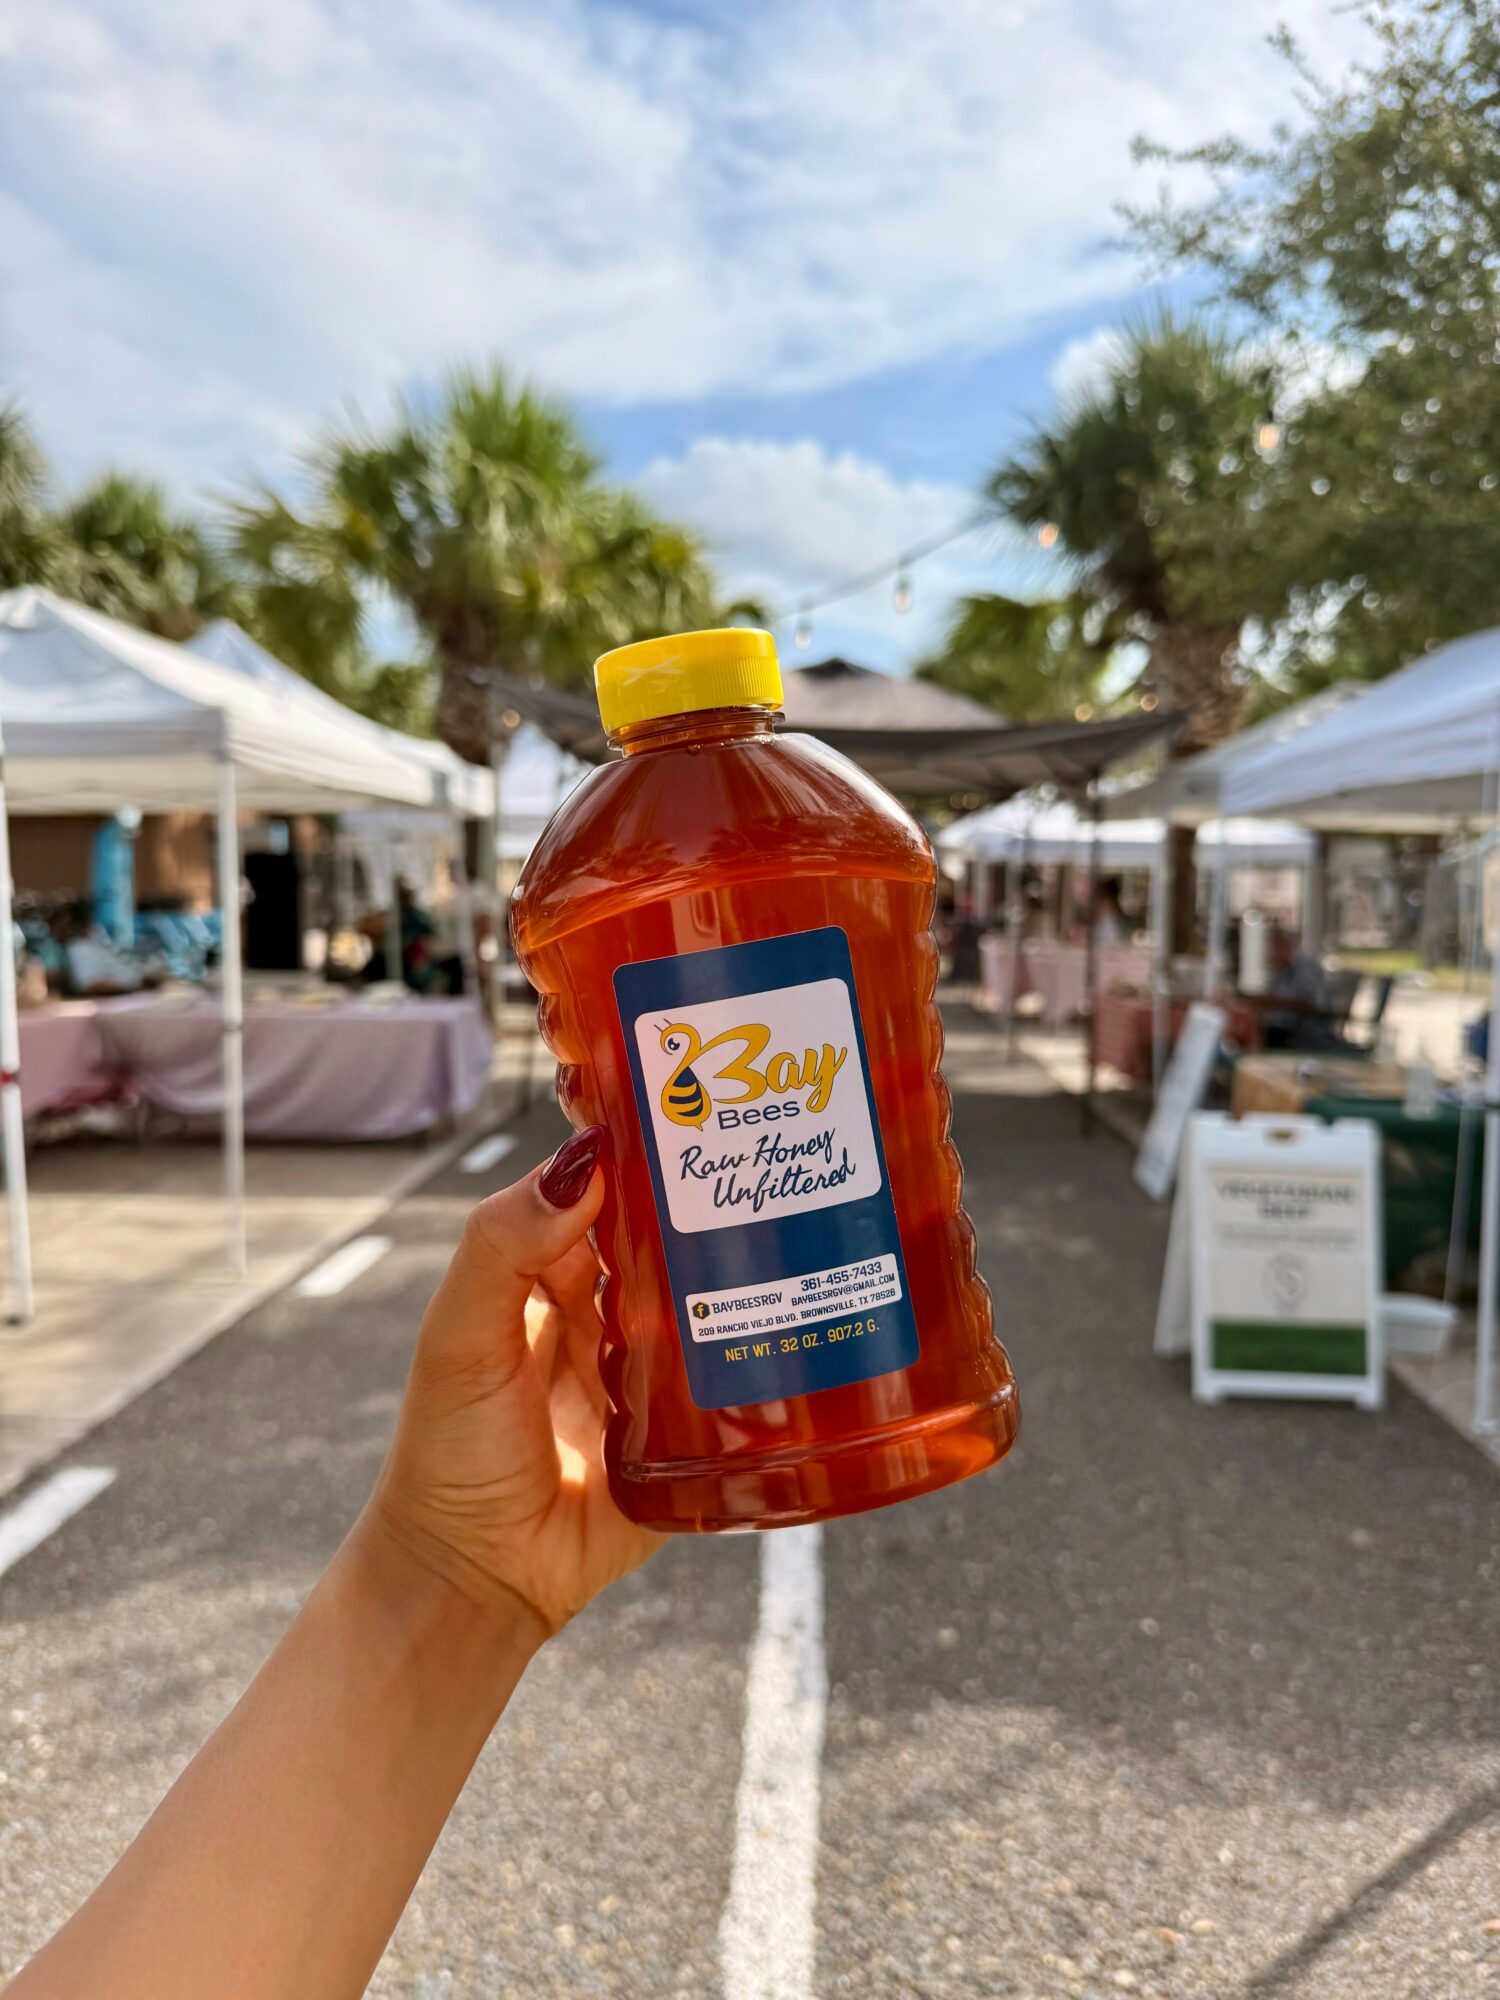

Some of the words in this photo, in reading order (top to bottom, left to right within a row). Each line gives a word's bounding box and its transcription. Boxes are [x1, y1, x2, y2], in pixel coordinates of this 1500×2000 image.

[701, 1023, 848, 1113] Bay
[717, 1101, 800, 1130] Bees
[680, 1145, 750, 1180] Raw
[753, 1128, 836, 1168] Honey
[713, 1147, 856, 1213] Unfiltered
[791, 1273, 895, 1307] BAYBEESRGV@GMAIL.COM
[801, 1261, 882, 1291] 361-455-7433
[698, 1328, 715, 1336] 209
[717, 1321, 749, 1334] RANCHO
[750, 1317, 774, 1329] VIEJO
[775, 1313, 799, 1325] BLVD.
[800, 1299, 857, 1319] BROWNSVILLE,
[858, 1296, 869, 1306] TX
[869, 1288, 896, 1302] 78526
[711, 1292, 782, 1314] BAYBEESRGV
[725, 1346, 749, 1362] NET
[752, 1342, 777, 1358] WT.
[780, 1337, 799, 1353] 32
[802, 1333, 824, 1349] OZ.
[827, 1322, 864, 1343] 907.2
[866, 1318, 880, 1333] G.
